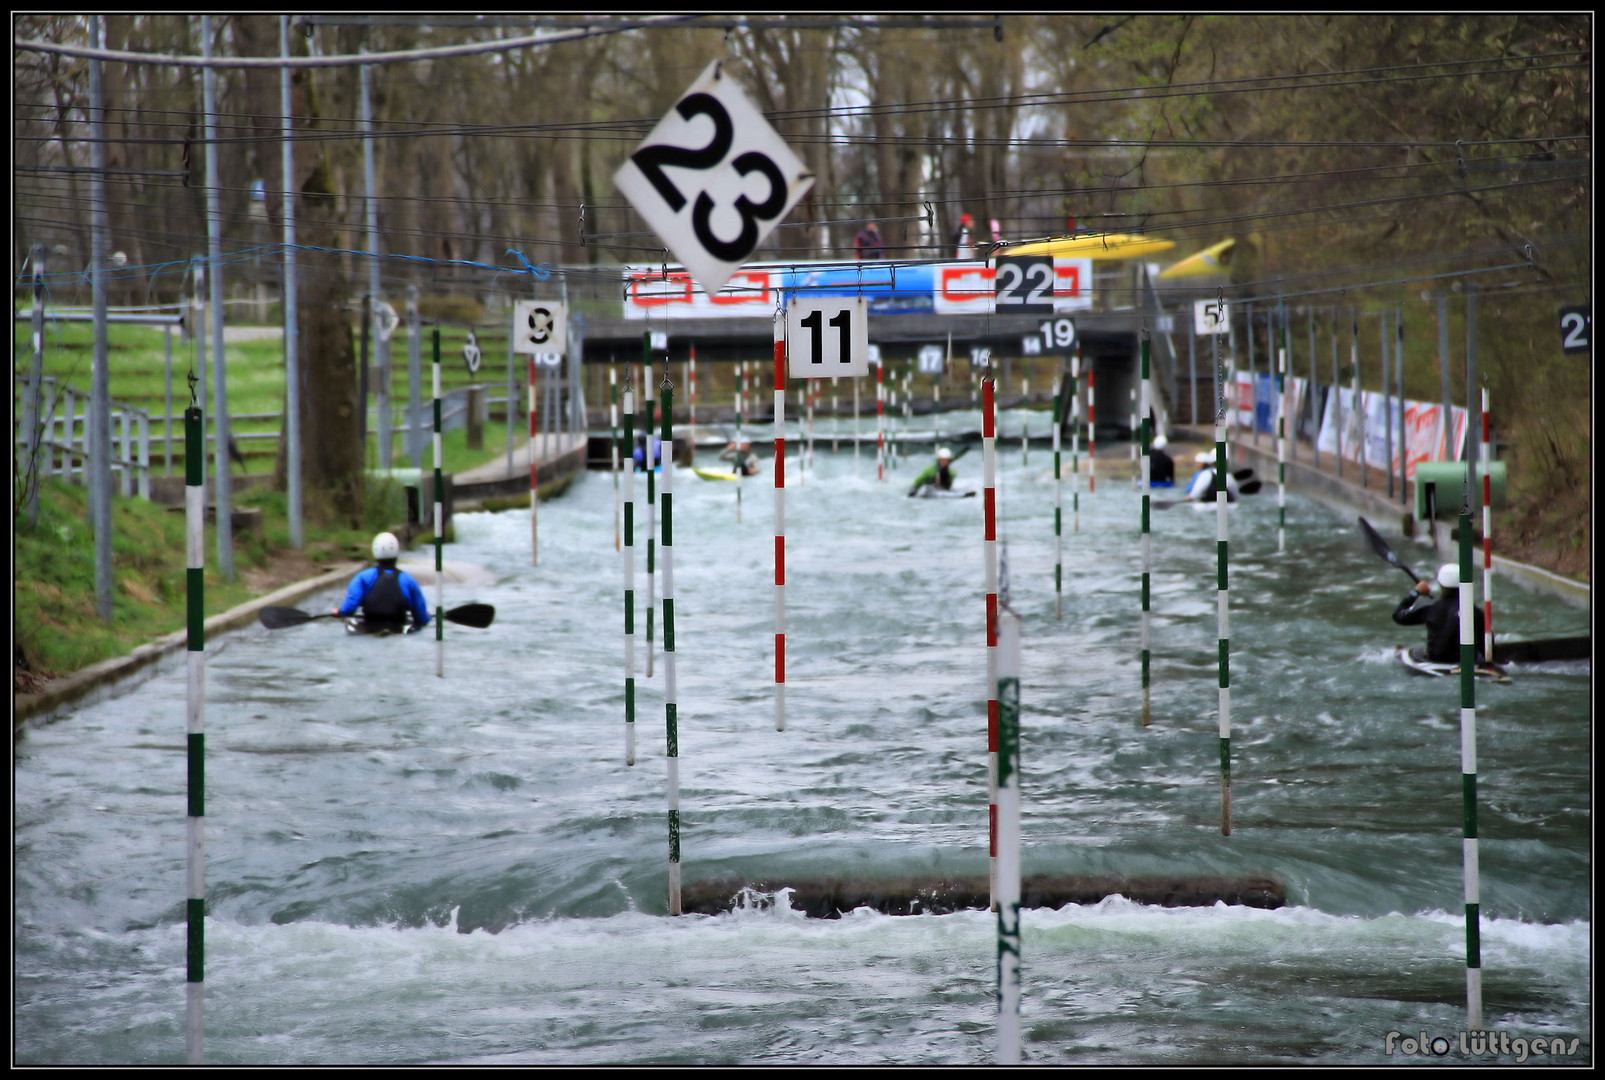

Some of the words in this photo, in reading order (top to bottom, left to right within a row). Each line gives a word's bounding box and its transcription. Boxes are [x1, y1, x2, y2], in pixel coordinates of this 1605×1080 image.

[631, 92, 788, 263] 23
[995, 262, 1054, 305] 22
[528, 307, 554, 345] 9
[801, 309, 851, 364] 11
[1040, 318, 1075, 349] 19
[918, 348, 942, 372] 17
[970, 347, 991, 368] 16
